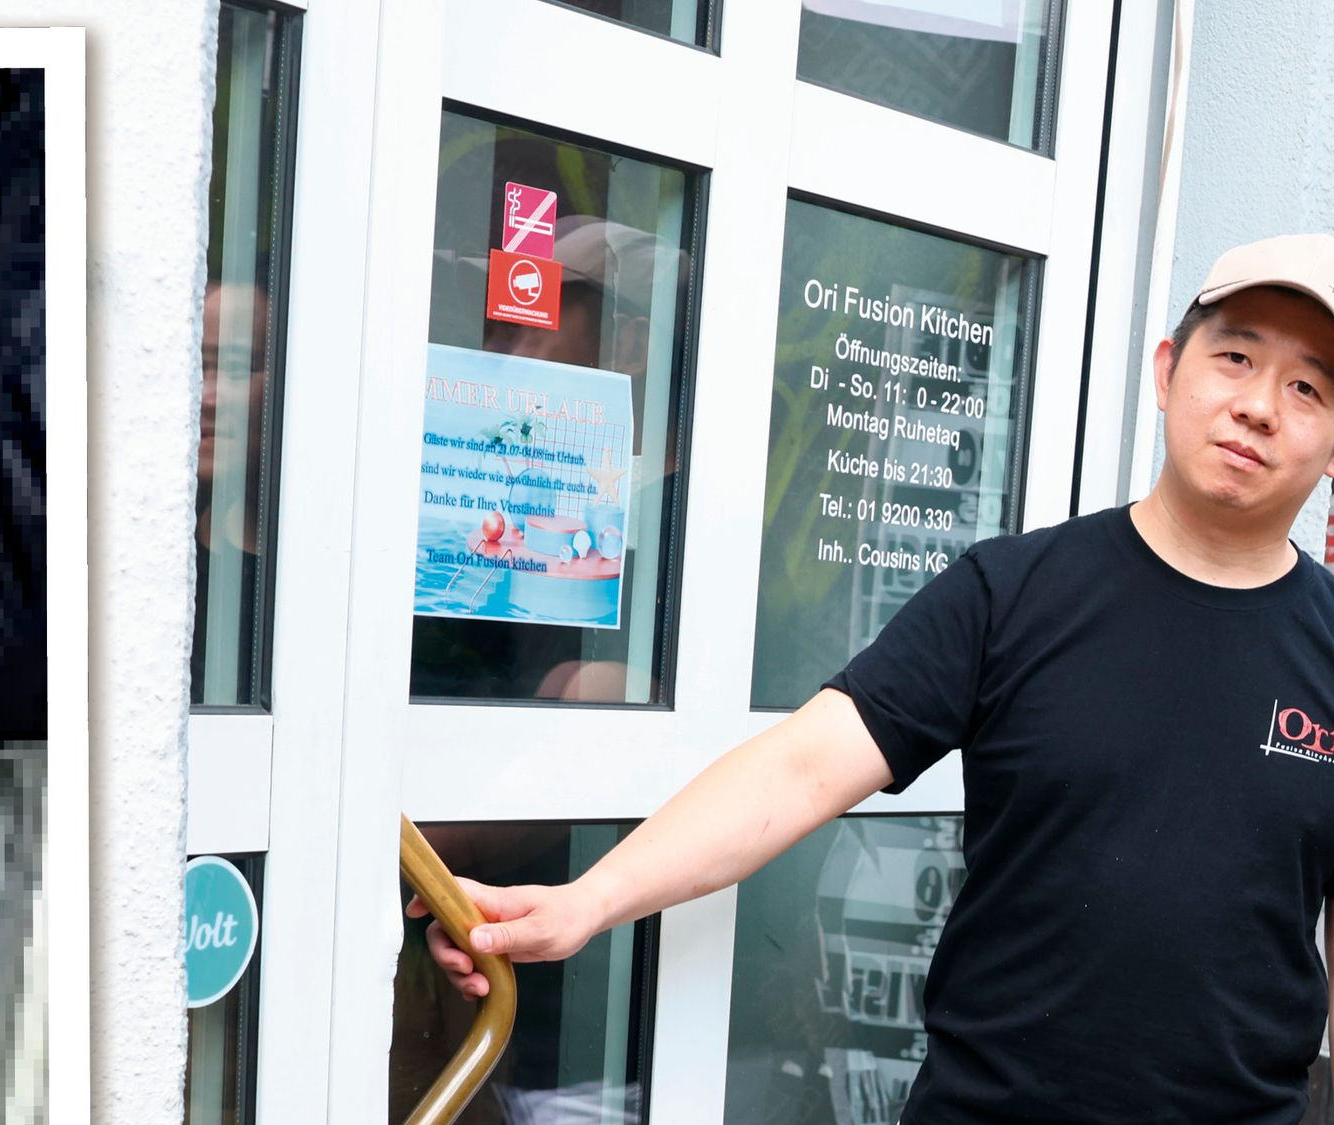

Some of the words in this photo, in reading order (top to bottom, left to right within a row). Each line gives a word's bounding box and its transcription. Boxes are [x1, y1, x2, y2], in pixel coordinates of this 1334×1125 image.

[804, 279, 838, 312] Ori
[844, 286, 914, 329] Fusion
[920, 305, 993, 347] Kitchen
[835, 332, 962, 384] Öffnungszeiten:
[810, 365, 829, 390] Di
[850, 374, 877, 400] So.
[506, 386, 605, 425] URLAUB
[826, 403, 890, 441] Montag
[423, 432, 449, 449] Gäste
[449, 436, 466, 450] wir
[466, 437, 484, 451] sind
[420, 463, 439, 476] sind
[440, 465, 456, 478] wir
[458, 467, 487, 481] wieder
[488, 470, 504, 482] wie
[827, 448, 879, 478] Küche
[883, 457, 906, 482] bis
[909, 462, 953, 489] 21:30
[424, 490, 457, 507] Danke
[459, 493, 474, 509] für
[477, 496, 497, 511] Ihre
[500, 499, 556, 519] Verständnis
[819, 492, 852, 519] Tel.:
[857, 498, 876, 522] 01
[881, 502, 921, 528] 9200
[924, 507, 953, 532] 330
[426, 549, 455, 565] Team
[476, 553, 510, 570] Fusion
[511, 556, 548, 573] kitchen
[858, 543, 921, 571] Cousins
[924, 550, 949, 574] KG
